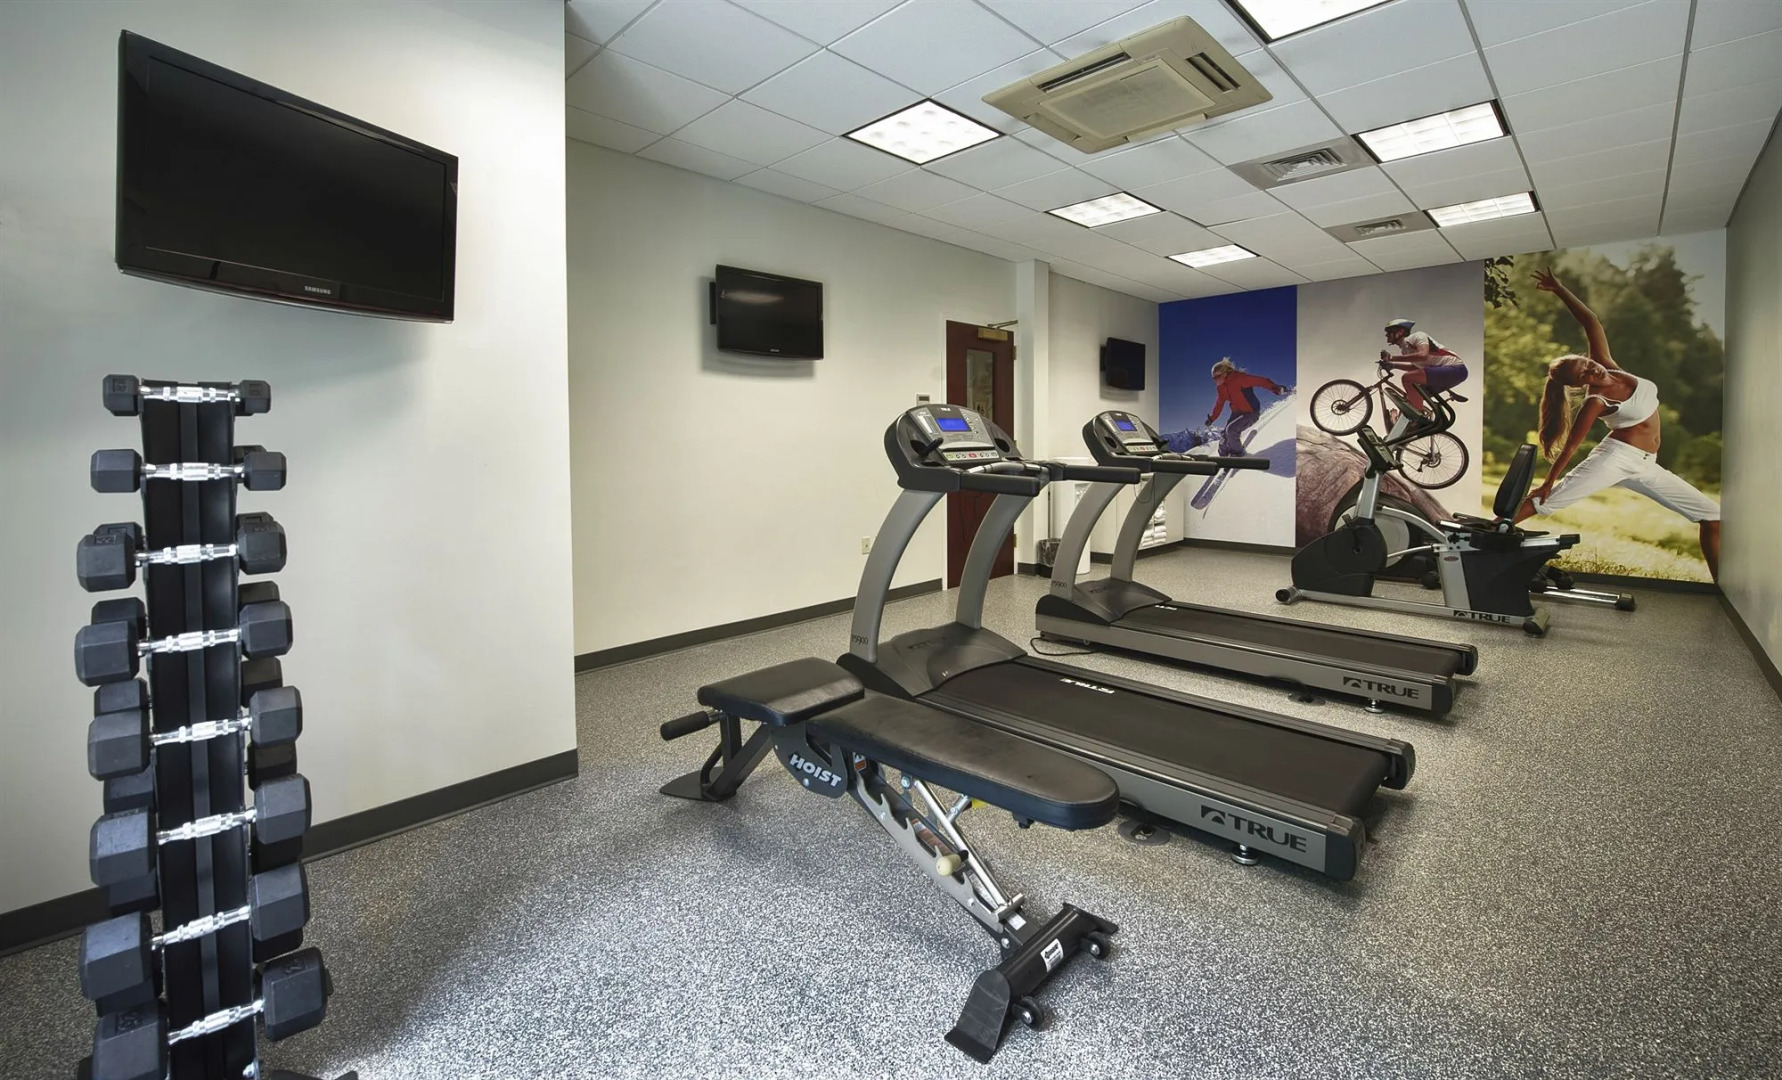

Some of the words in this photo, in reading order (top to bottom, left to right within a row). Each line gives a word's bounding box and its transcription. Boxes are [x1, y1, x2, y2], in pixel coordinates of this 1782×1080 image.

[1468, 610, 1511, 624] TRUE
[1363, 679, 1419, 699] TRUE
[789, 753, 842, 787] HOIST
[1227, 813, 1307, 853] TRUE
